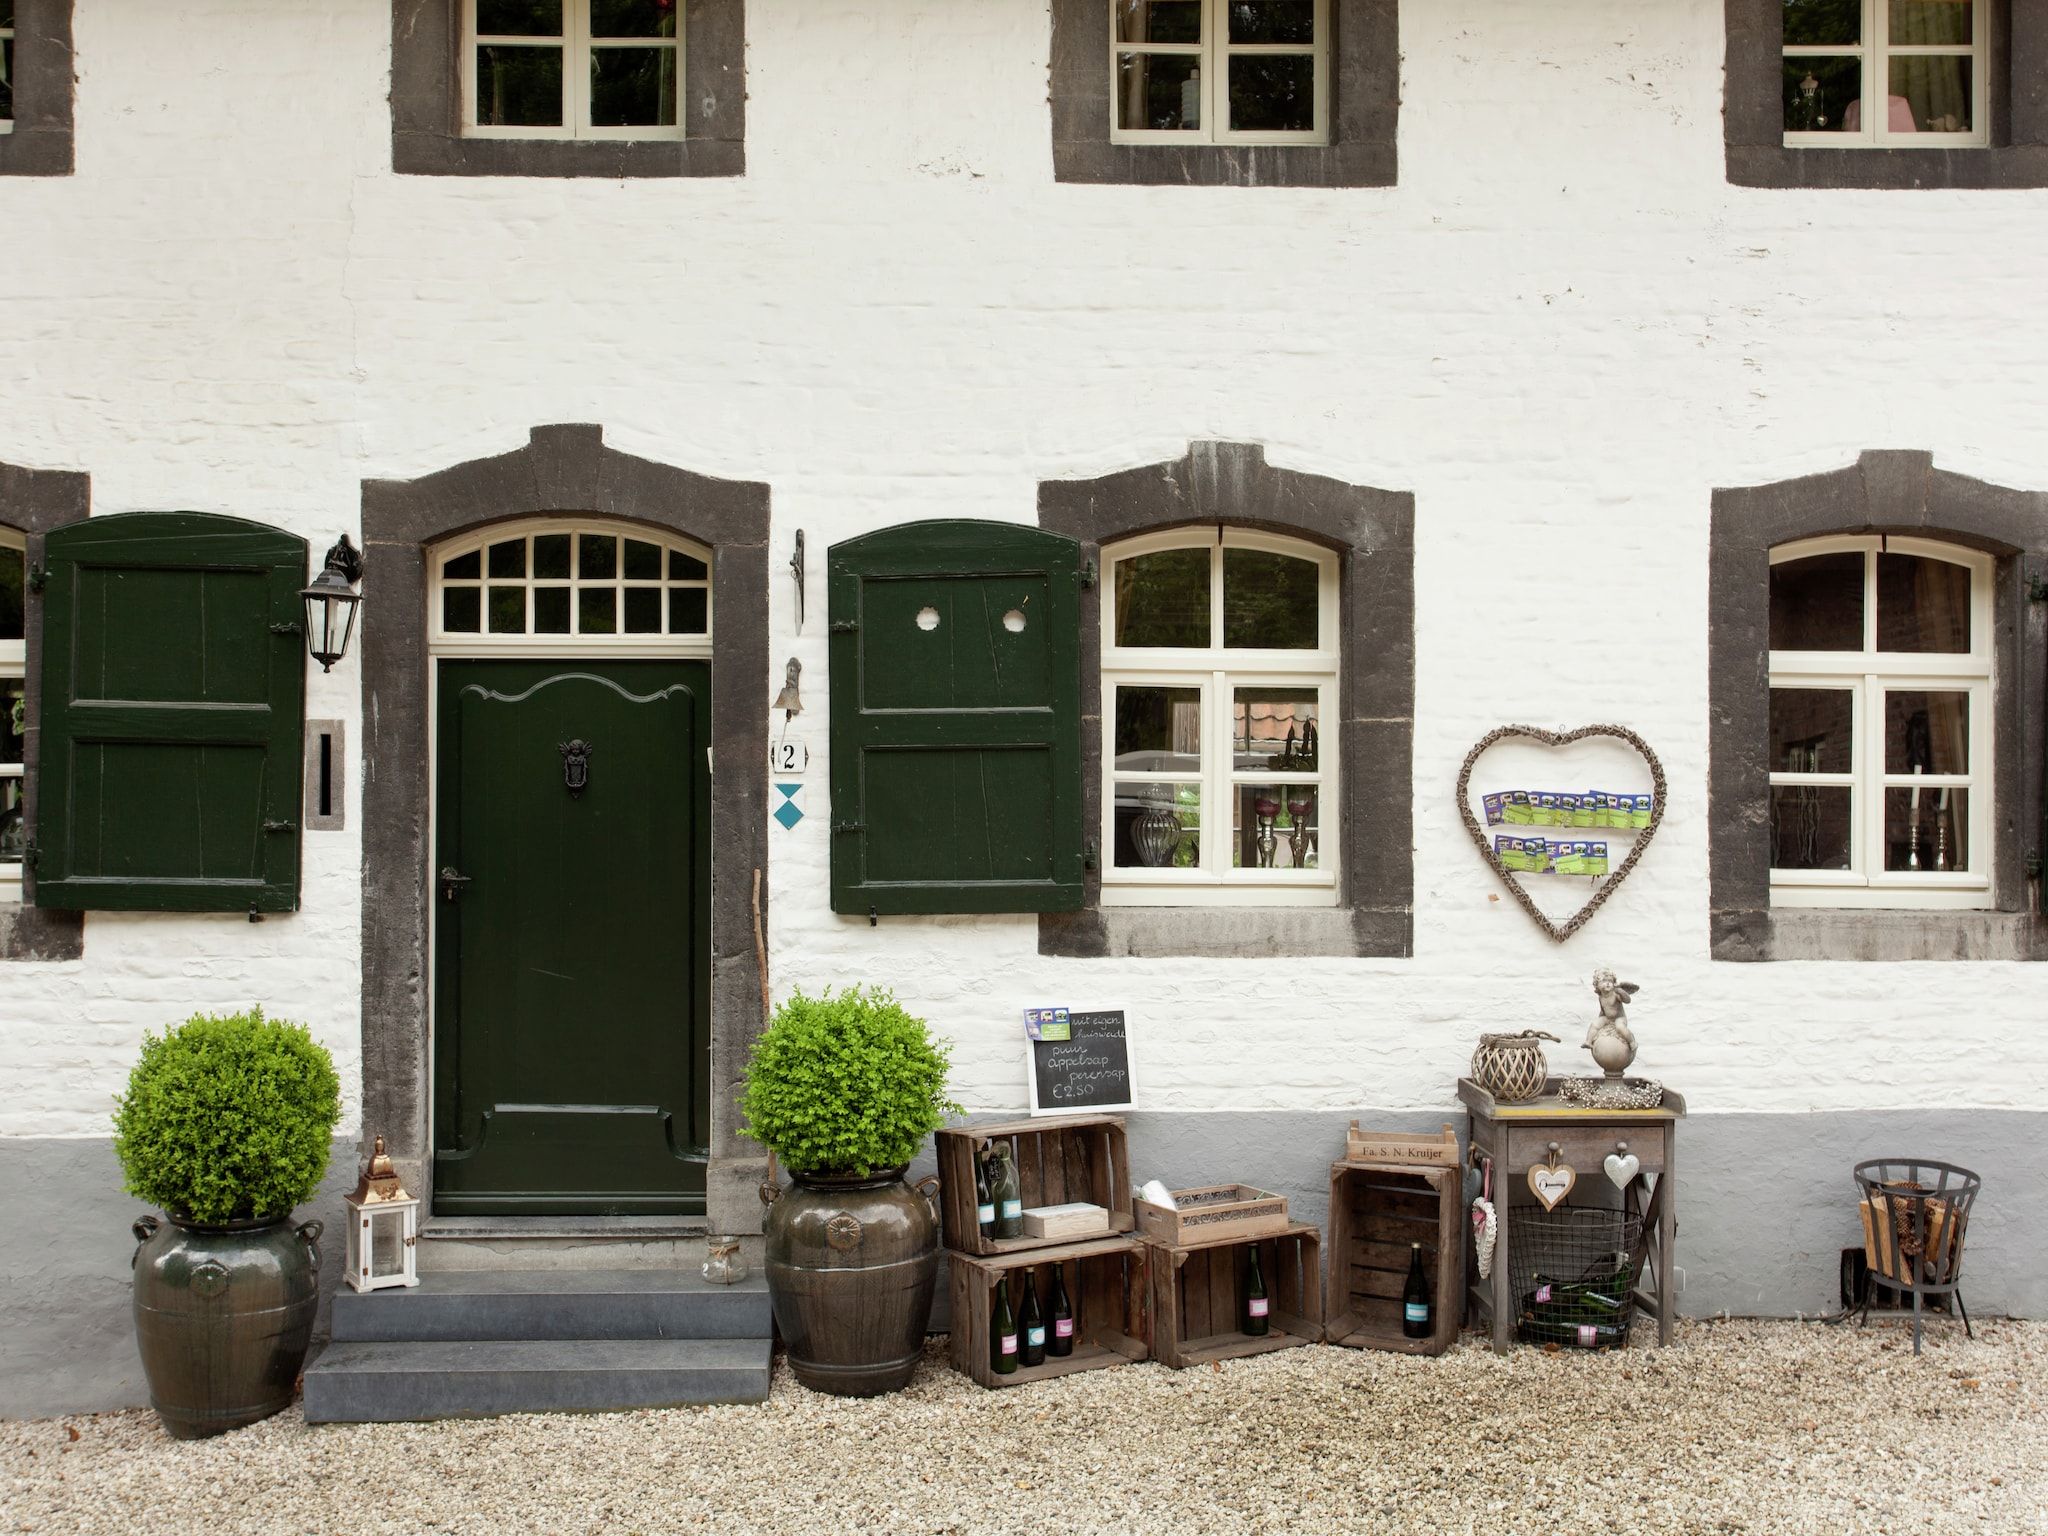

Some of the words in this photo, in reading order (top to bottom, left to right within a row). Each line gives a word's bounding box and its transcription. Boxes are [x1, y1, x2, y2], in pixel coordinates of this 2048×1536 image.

[783, 745, 795, 769] 2
[1092, 1016, 1121, 1030] eigen
[1052, 1046, 1088, 1057] puur
[1047, 1054, 1109, 1072] appelsap
[1069, 1069, 1126, 1086] perensap
[1362, 1147, 1377, 1156] Fa.
[1380, 1147, 1390, 1157] S.
[1393, 1147, 1405, 1157] N.
[1408, 1147, 1443, 1160] Kruijer
